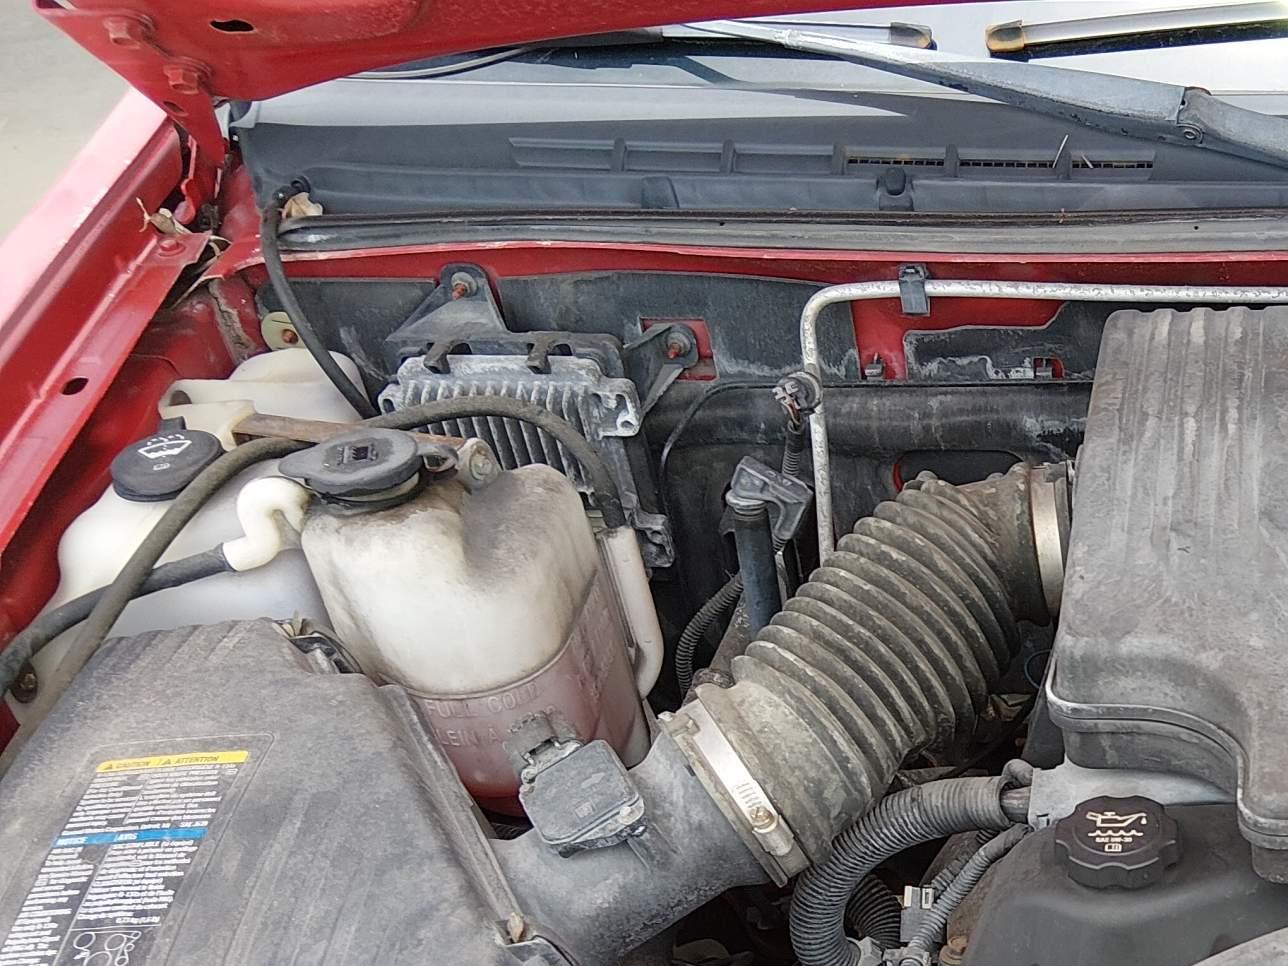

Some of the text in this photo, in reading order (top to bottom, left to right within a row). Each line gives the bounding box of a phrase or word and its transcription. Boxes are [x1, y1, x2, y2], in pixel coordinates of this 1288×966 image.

[425, 682, 540, 719] FULL COLD
[437, 729, 480, 747] LEIN
